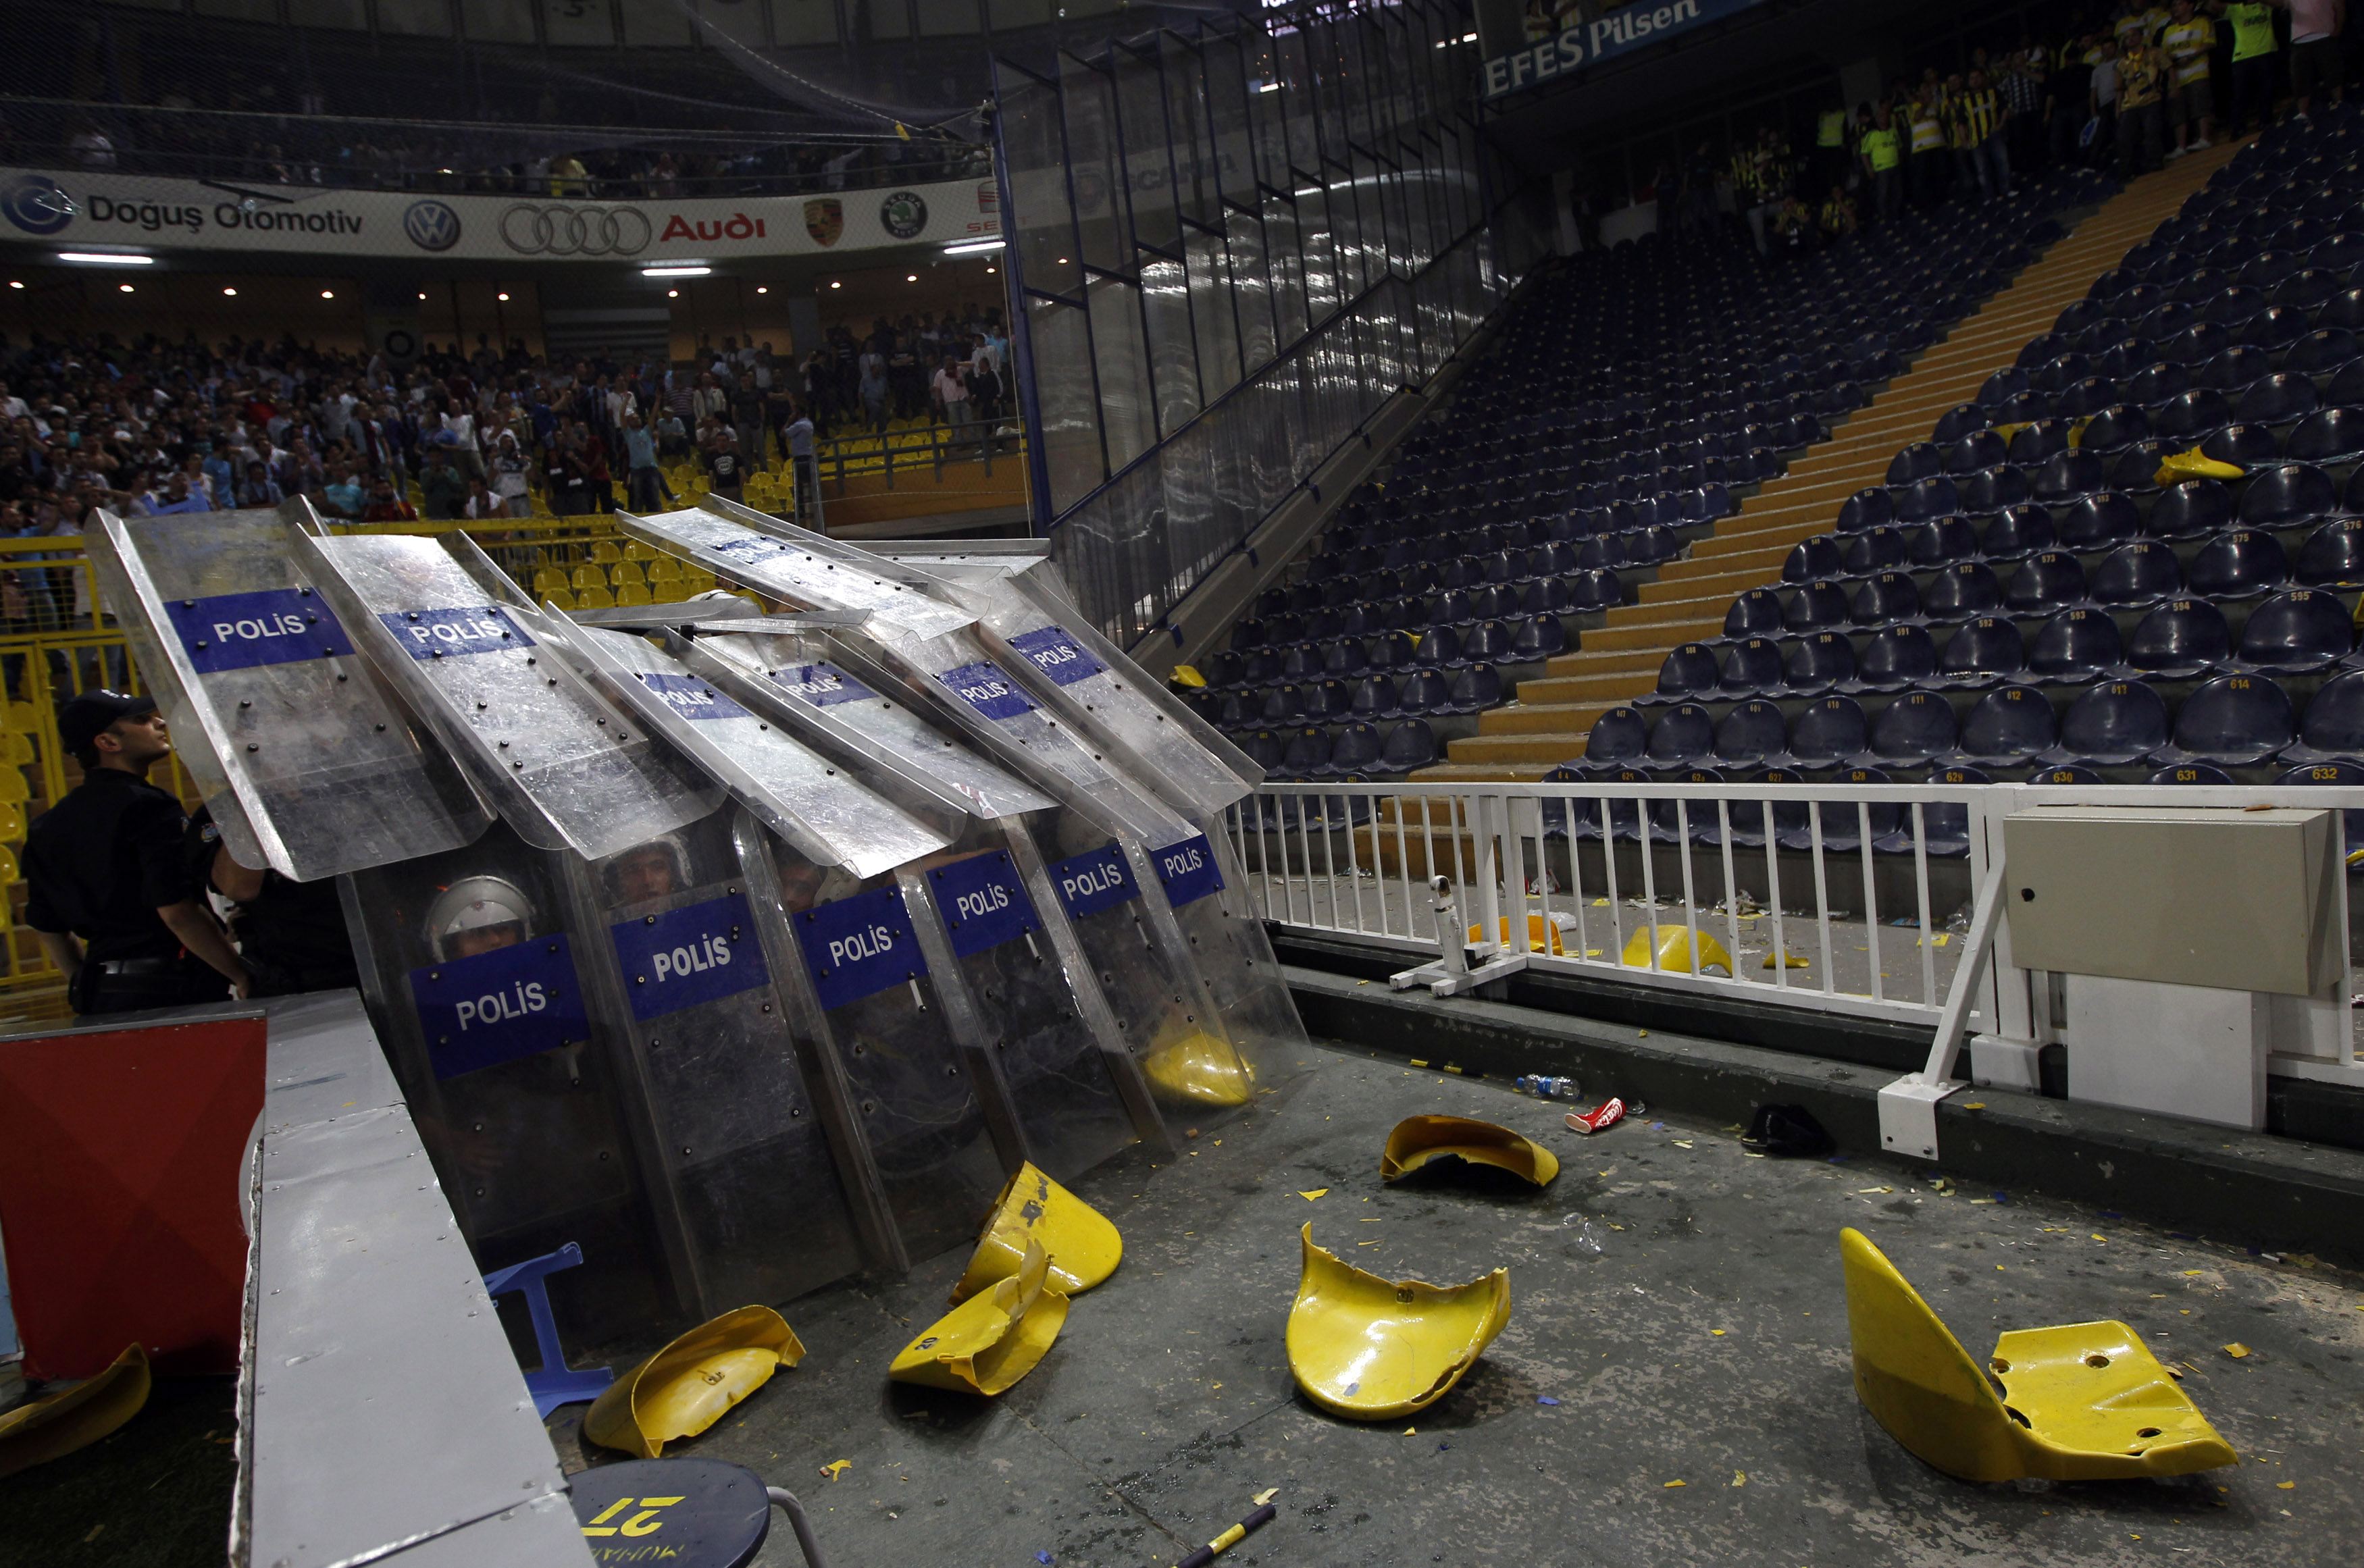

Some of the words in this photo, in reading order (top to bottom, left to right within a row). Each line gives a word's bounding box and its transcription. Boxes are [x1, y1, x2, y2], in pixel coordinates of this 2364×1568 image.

[1487, 30, 1584, 97] EFES
[1589, 0, 1701, 59] Pilsen
[88, 195, 203, 234] Doğuş
[214, 203, 362, 235] Otomotiv
[660, 213, 766, 242] Audi
[2343, 521, 2362, 531] 576
[2233, 533, 2250, 543] 575
[2134, 545, 2149, 554] 574
[2042, 554, 2056, 563] 573
[1960, 566, 1974, 574] 572
[1882, 574, 1894, 583] 571
[2291, 592, 2310, 602] 595
[2173, 601, 2190, 612] 594
[2070, 611, 2086, 620] 593
[213, 612, 307, 642] POLİS
[1979, 619, 1993, 628] 592
[408, 618, 505, 644] POLİS
[1897, 627, 1909, 636] 591
[1820, 634, 1832, 643] 590
[1033, 644, 1077, 669] POLİS
[2230, 679, 2250, 689] 614
[962, 681, 1007, 703] POLİS
[2007, 690, 2021, 700] 612
[1911, 696, 1924, 704] 611
[1768, 773, 1782, 782] 627
[1852, 771, 1866, 781] 628
[1946, 772, 1963, 782] 629
[2053, 771, 2073, 783] 630
[2177, 769, 2196, 781] 631
[2312, 768, 2338, 780] 632
[1164, 847, 1202, 878] POLİS
[1063, 862, 1122, 901] POLİS
[956, 882, 1008, 920] POLİS
[829, 924, 892, 966] POLİS
[652, 933, 731, 982] POLİS
[456, 981, 546, 1030] POLİS
[581, 1496, 686, 1537] 27
